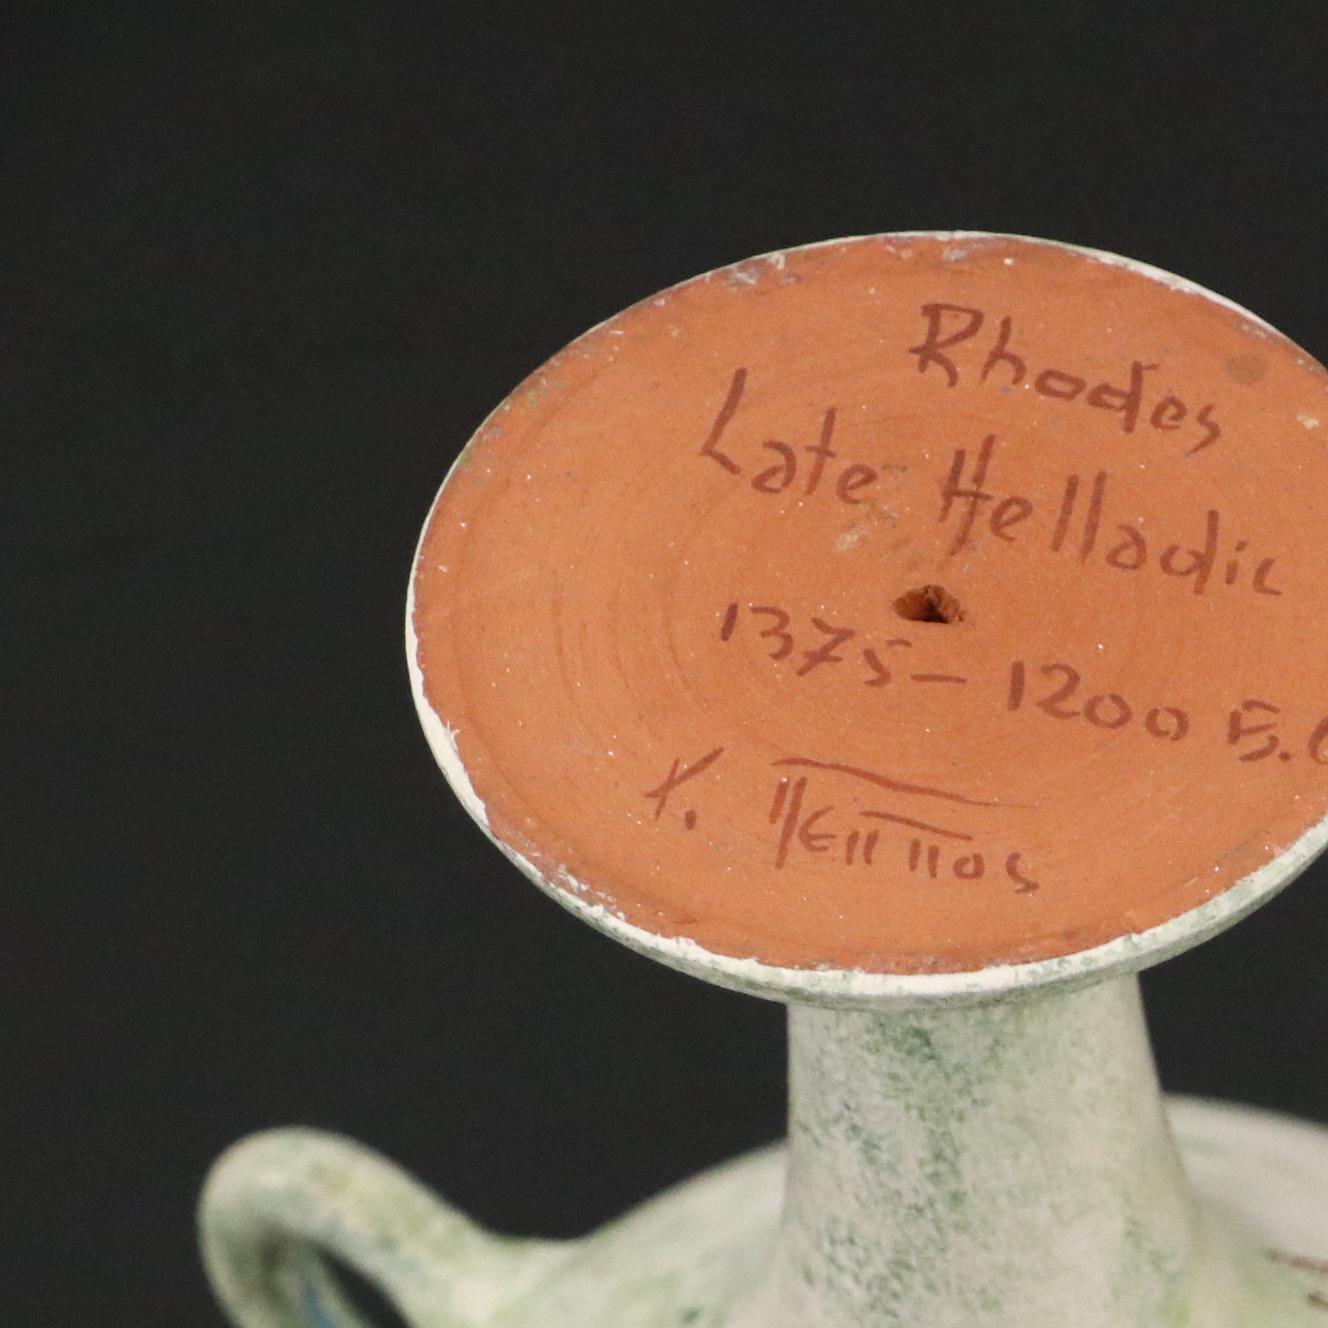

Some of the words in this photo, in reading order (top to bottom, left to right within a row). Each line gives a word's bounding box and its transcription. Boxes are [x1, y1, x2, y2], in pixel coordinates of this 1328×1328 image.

[909, 302, 1222, 453] Rhodes
[699, 368, 878, 503] Late
[938, 433, 1283, 597] Helladic
[1008, 660, 1189, 741] 1200
